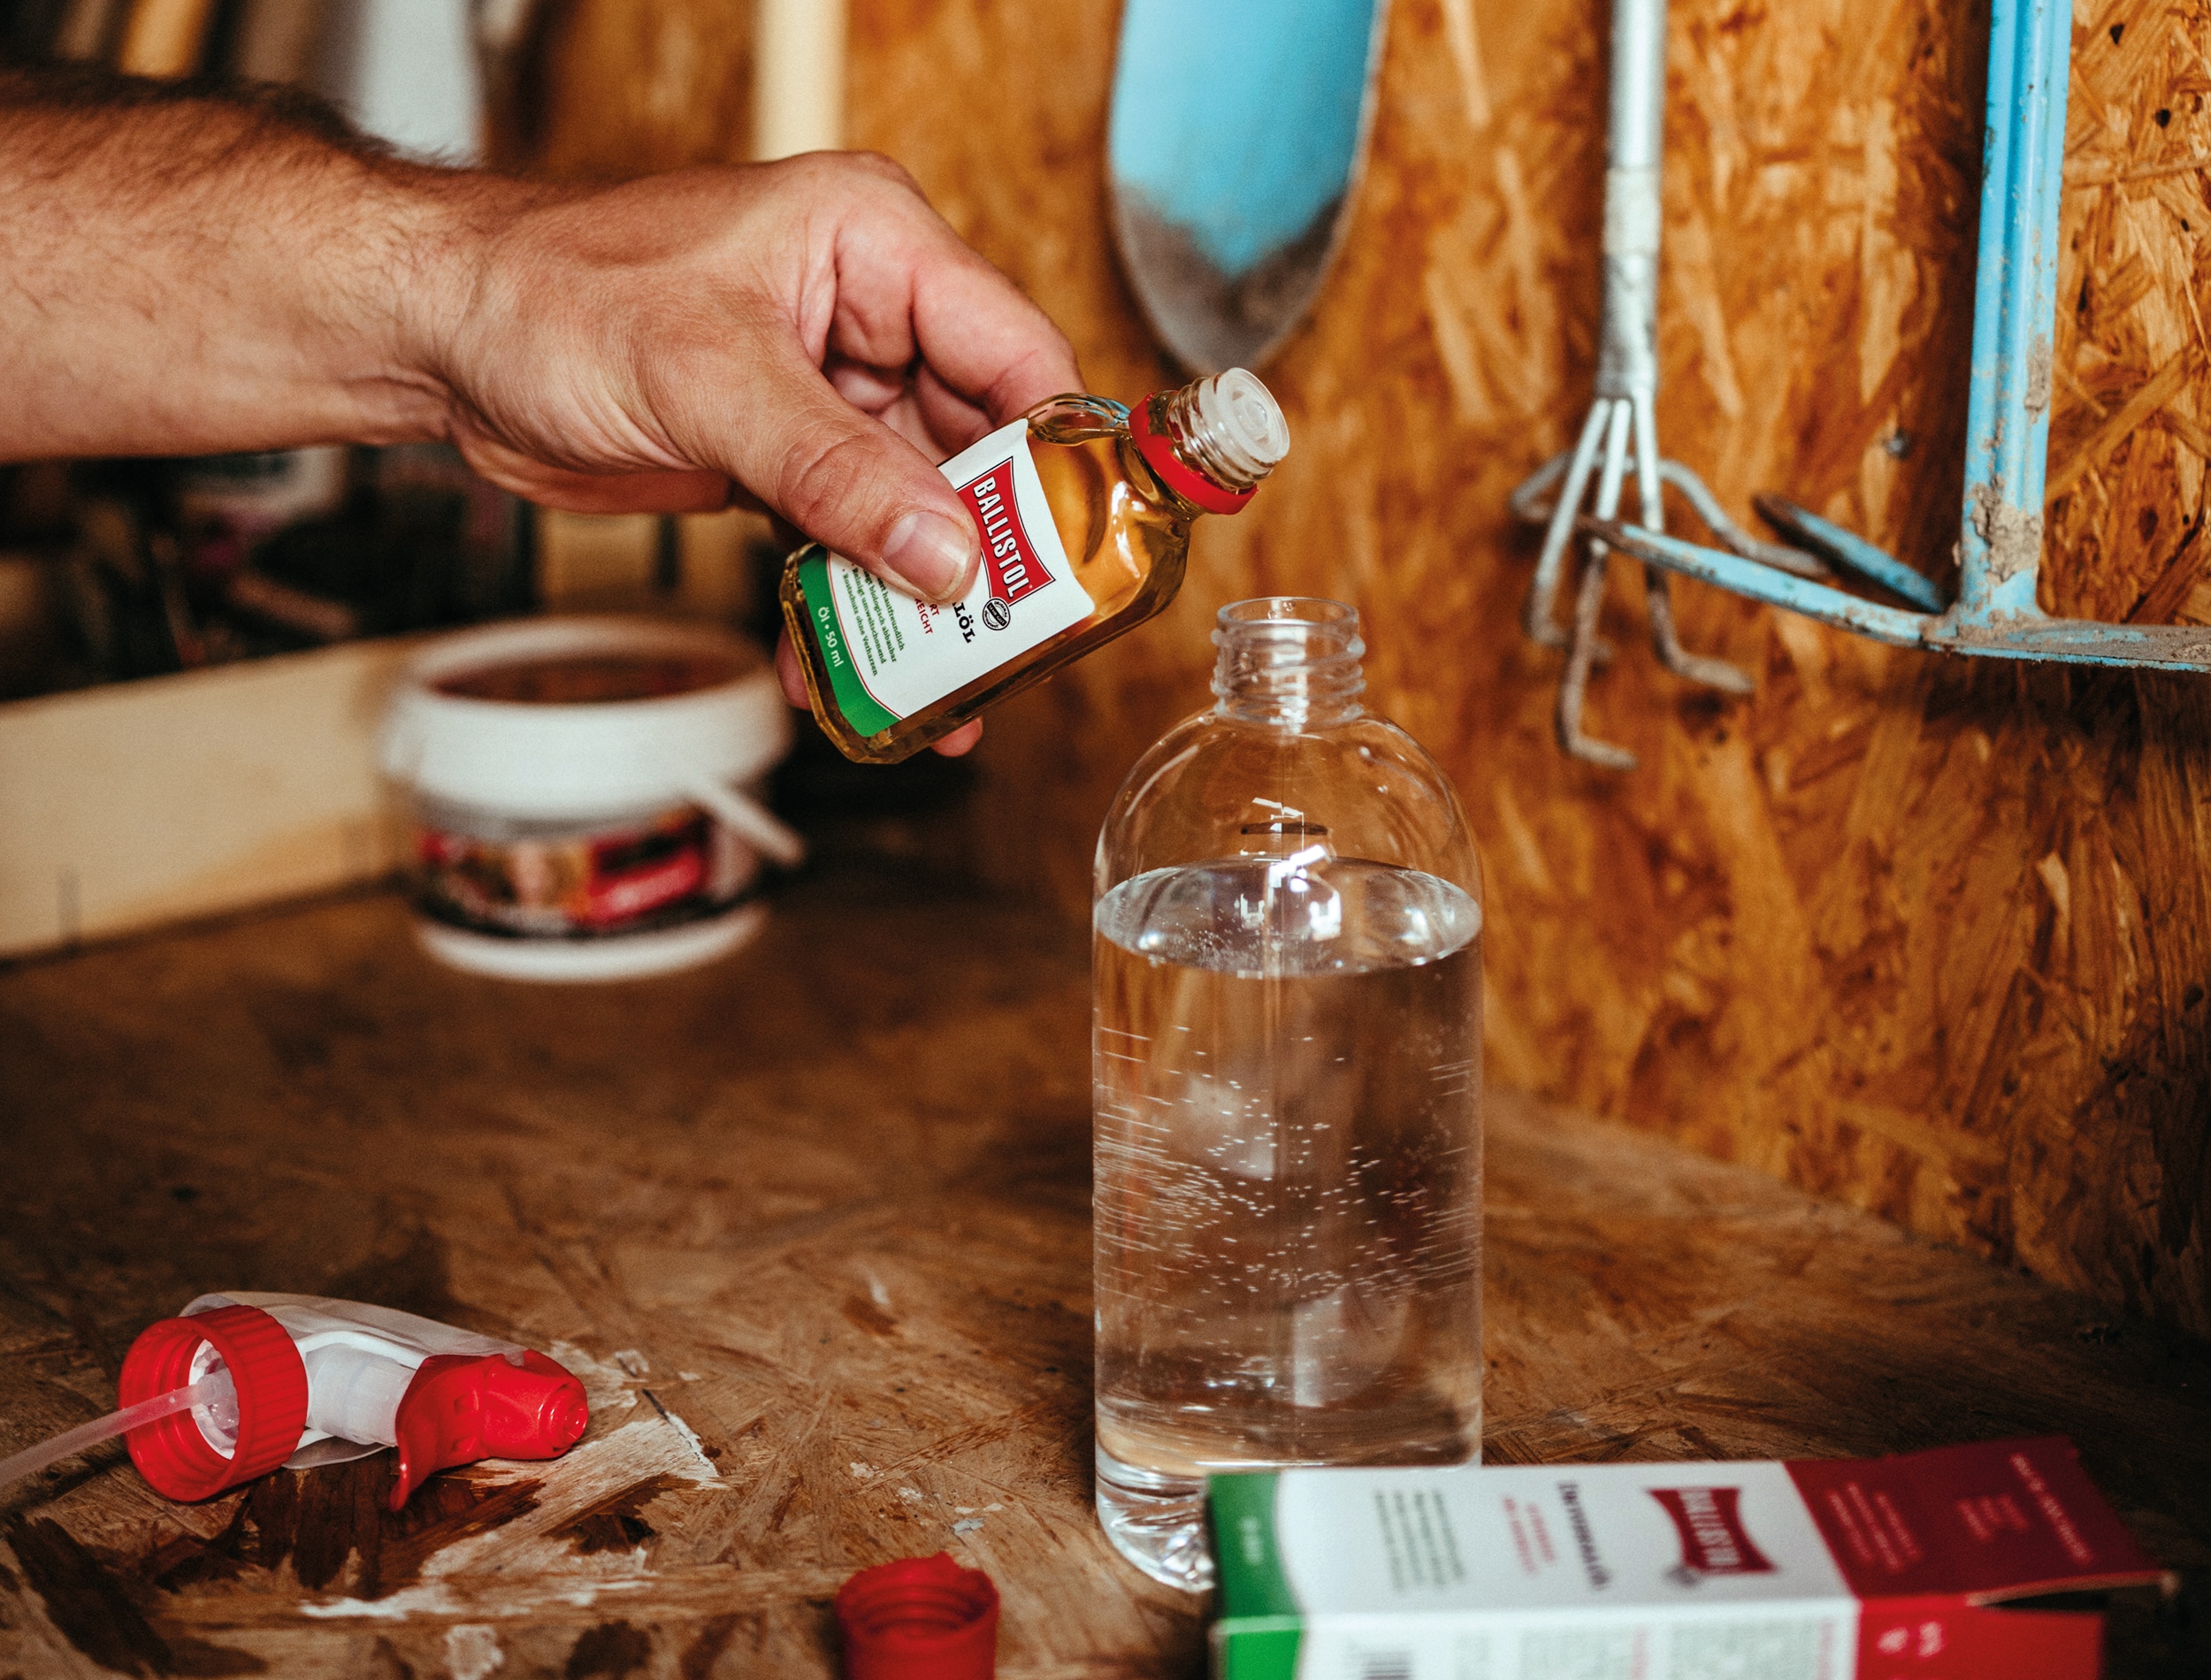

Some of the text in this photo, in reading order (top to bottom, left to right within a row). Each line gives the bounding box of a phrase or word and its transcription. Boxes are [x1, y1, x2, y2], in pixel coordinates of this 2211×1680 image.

[973, 476, 1030, 598] BALLISTOL
[817, 607, 845, 668] Öl 50 ml
[843, 573, 878, 676] Rostschutz ohne Verharzen
[853, 568, 887, 665] Reinigt umweltschonend
[868, 584, 884, 626] biologisch
[882, 626, 898, 663] abbaubar
[883, 591, 905, 651] hautfreundlich
[914, 598, 933, 634] REICHT
[929, 603, 940, 616] RT
[952, 601, 975, 644] LÖL
